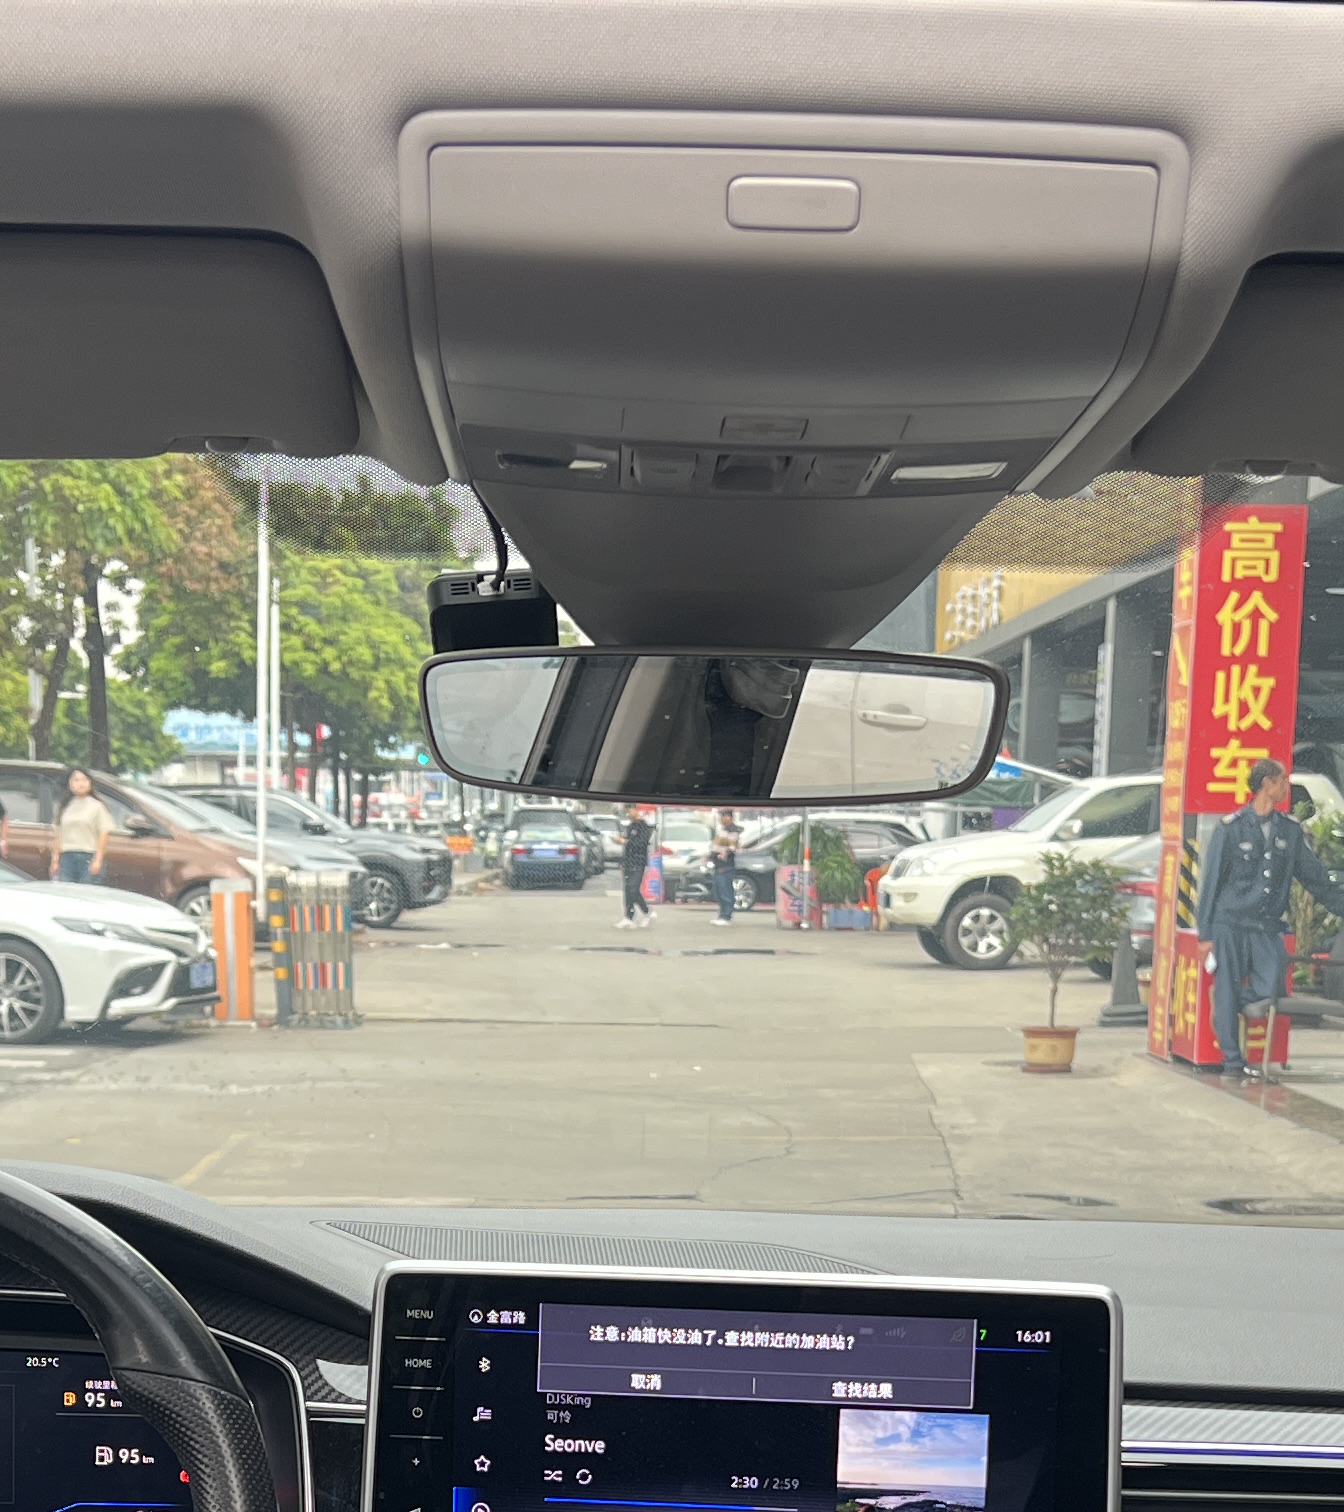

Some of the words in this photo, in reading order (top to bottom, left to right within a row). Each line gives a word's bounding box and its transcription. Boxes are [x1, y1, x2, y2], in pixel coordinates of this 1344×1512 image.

[1205, 516, 1284, 805] 高价收车
[406, 1308, 434, 1321] MENU
[486, 1309, 526, 1325] 金富路
[1015, 1330, 1051, 1344] 16:01
[26, 1356, 60, 1368] 20.5°C
[404, 1358, 433, 1369] HOME
[630, 1373, 662, 1391] 取消
[831, 1381, 894, 1399] 查找结果
[84, 1392, 106, 1407] 95
[544, 1434, 606, 1454] Seonve
[118, 1448, 140, 1463] 95
[142, 1455, 155, 1464] km
[730, 1475, 759, 1489] 2:30
[772, 1478, 800, 1490] 2:59
